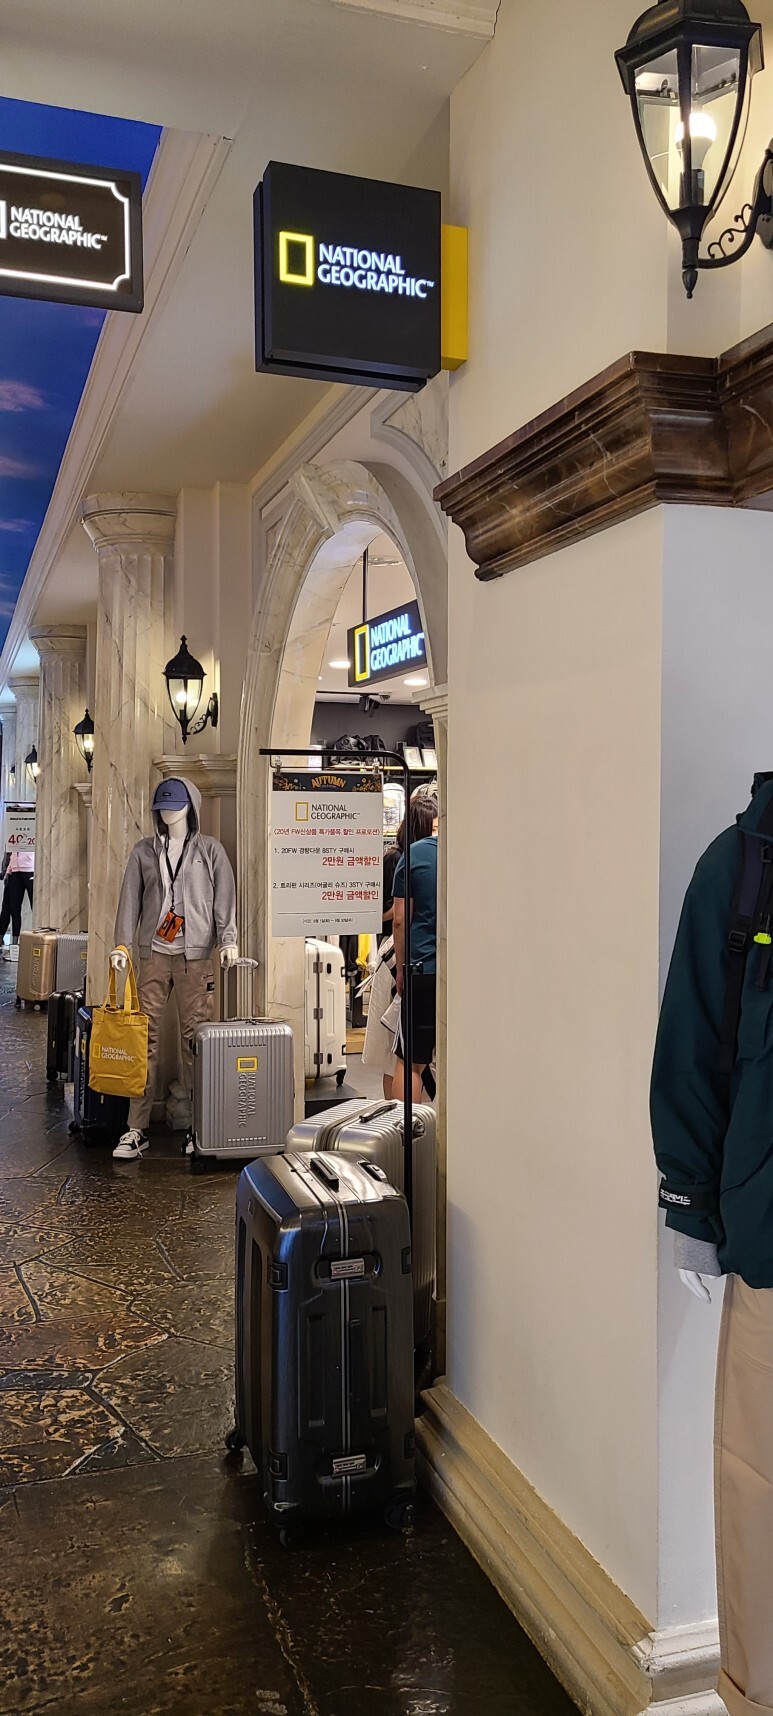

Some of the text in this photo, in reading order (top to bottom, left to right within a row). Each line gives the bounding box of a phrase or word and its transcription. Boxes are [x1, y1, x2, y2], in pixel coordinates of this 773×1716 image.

[10, 206, 83, 231] NATIONAL
[319, 243, 406, 275] NATIONAL
[370, 613, 412, 648] NATIONAL
[310, 775, 347, 788] AUTUMN
[311, 804, 347, 812] NATIONAL
[322, 856, 380, 866] 2만원 금액할인
[321, 890, 379, 901] 2만원 금액할인
[101, 1046, 128, 1056] NATIONAL
[238, 1072, 247, 1127] GEOGRAPHIC
[247, 1072, 257, 1117] NATIONAL
